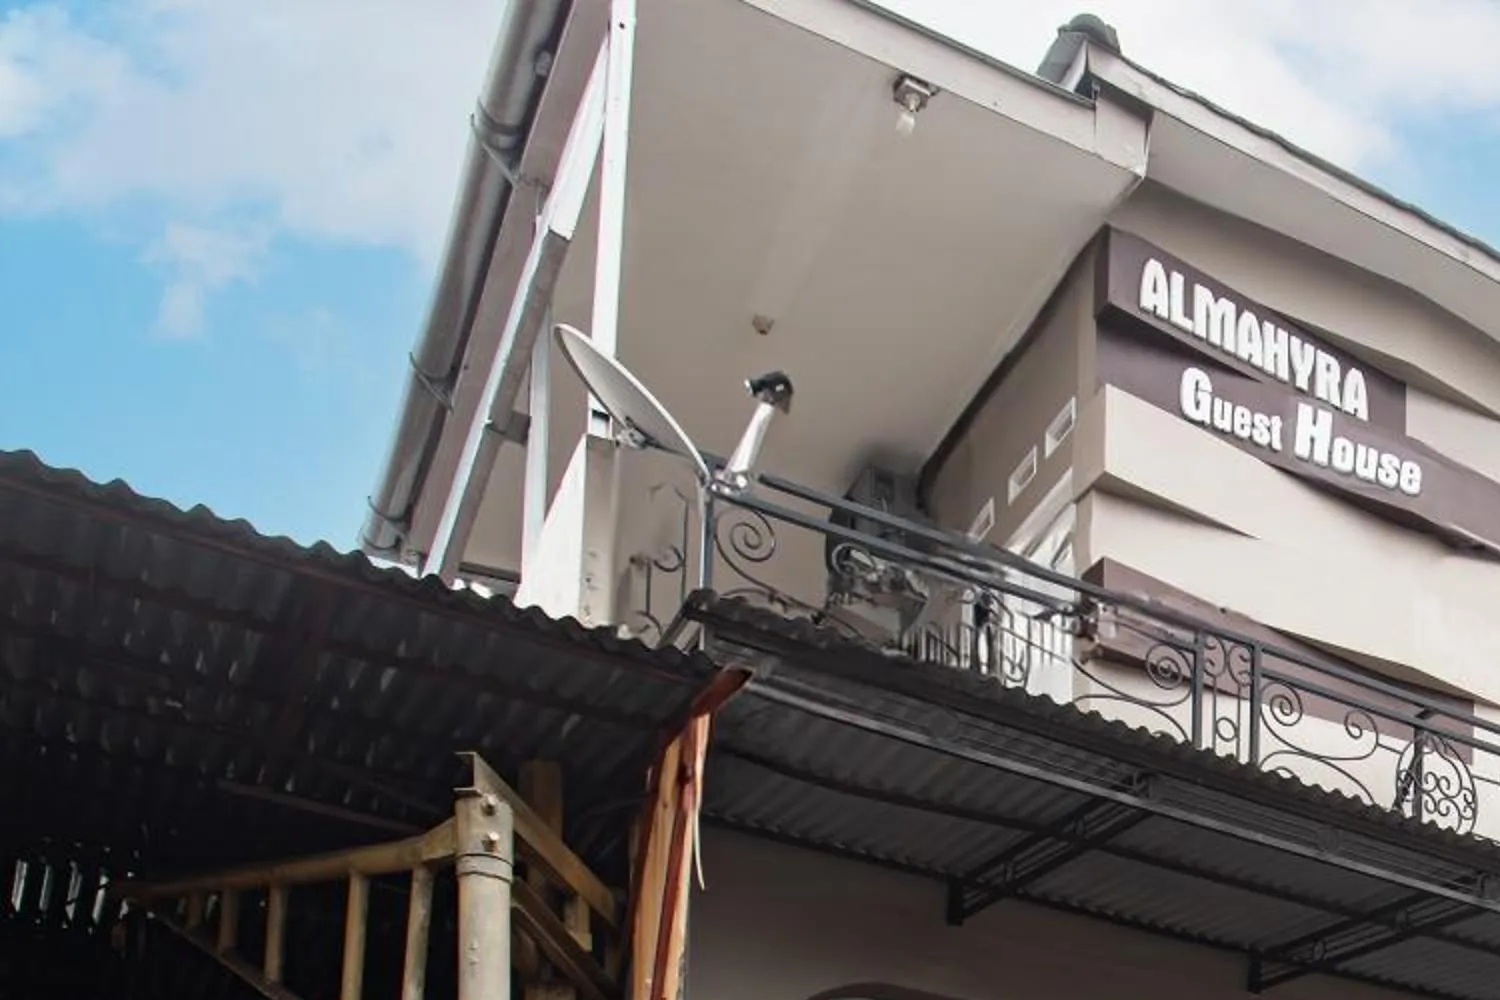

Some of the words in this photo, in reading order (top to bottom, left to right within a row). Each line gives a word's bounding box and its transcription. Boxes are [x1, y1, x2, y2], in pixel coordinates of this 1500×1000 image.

[1139, 258, 1369, 421] ALMAHYRA
[1180, 367, 1283, 451] Guest
[1294, 403, 1422, 494] House
